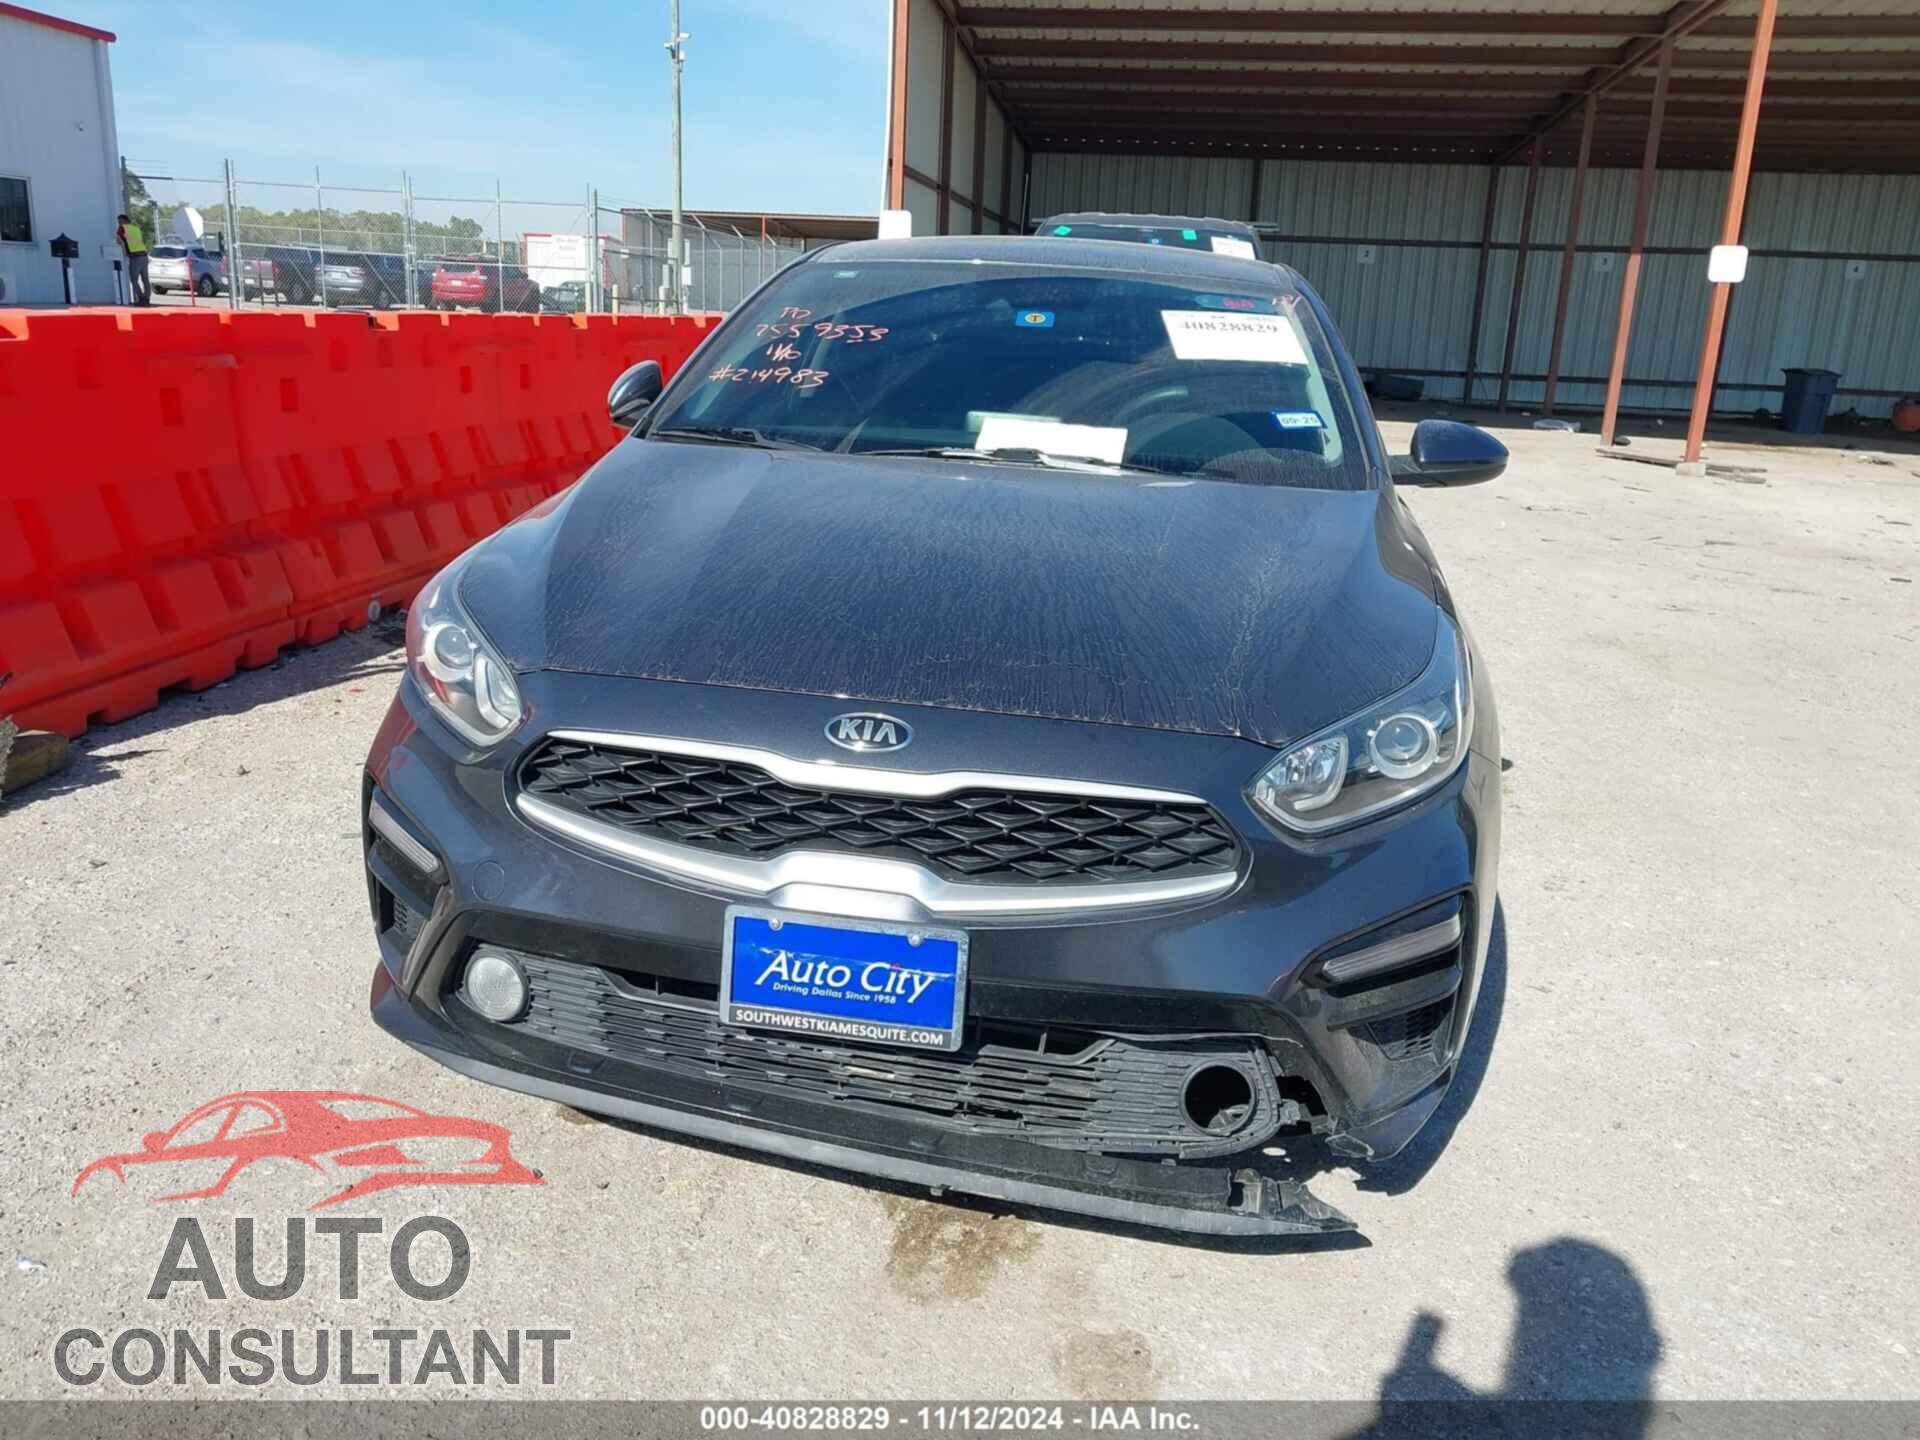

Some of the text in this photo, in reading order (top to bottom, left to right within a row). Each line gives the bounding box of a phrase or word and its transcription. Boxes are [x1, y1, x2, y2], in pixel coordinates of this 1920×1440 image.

[838, 718, 898, 744] KIA
[755, 950, 942, 1003] Auto City
[773, 982, 897, 1005] Driving Dallas Since 1958
[735, 1009, 944, 1046] SOUTHWESTKIAMESQUITE.COM
